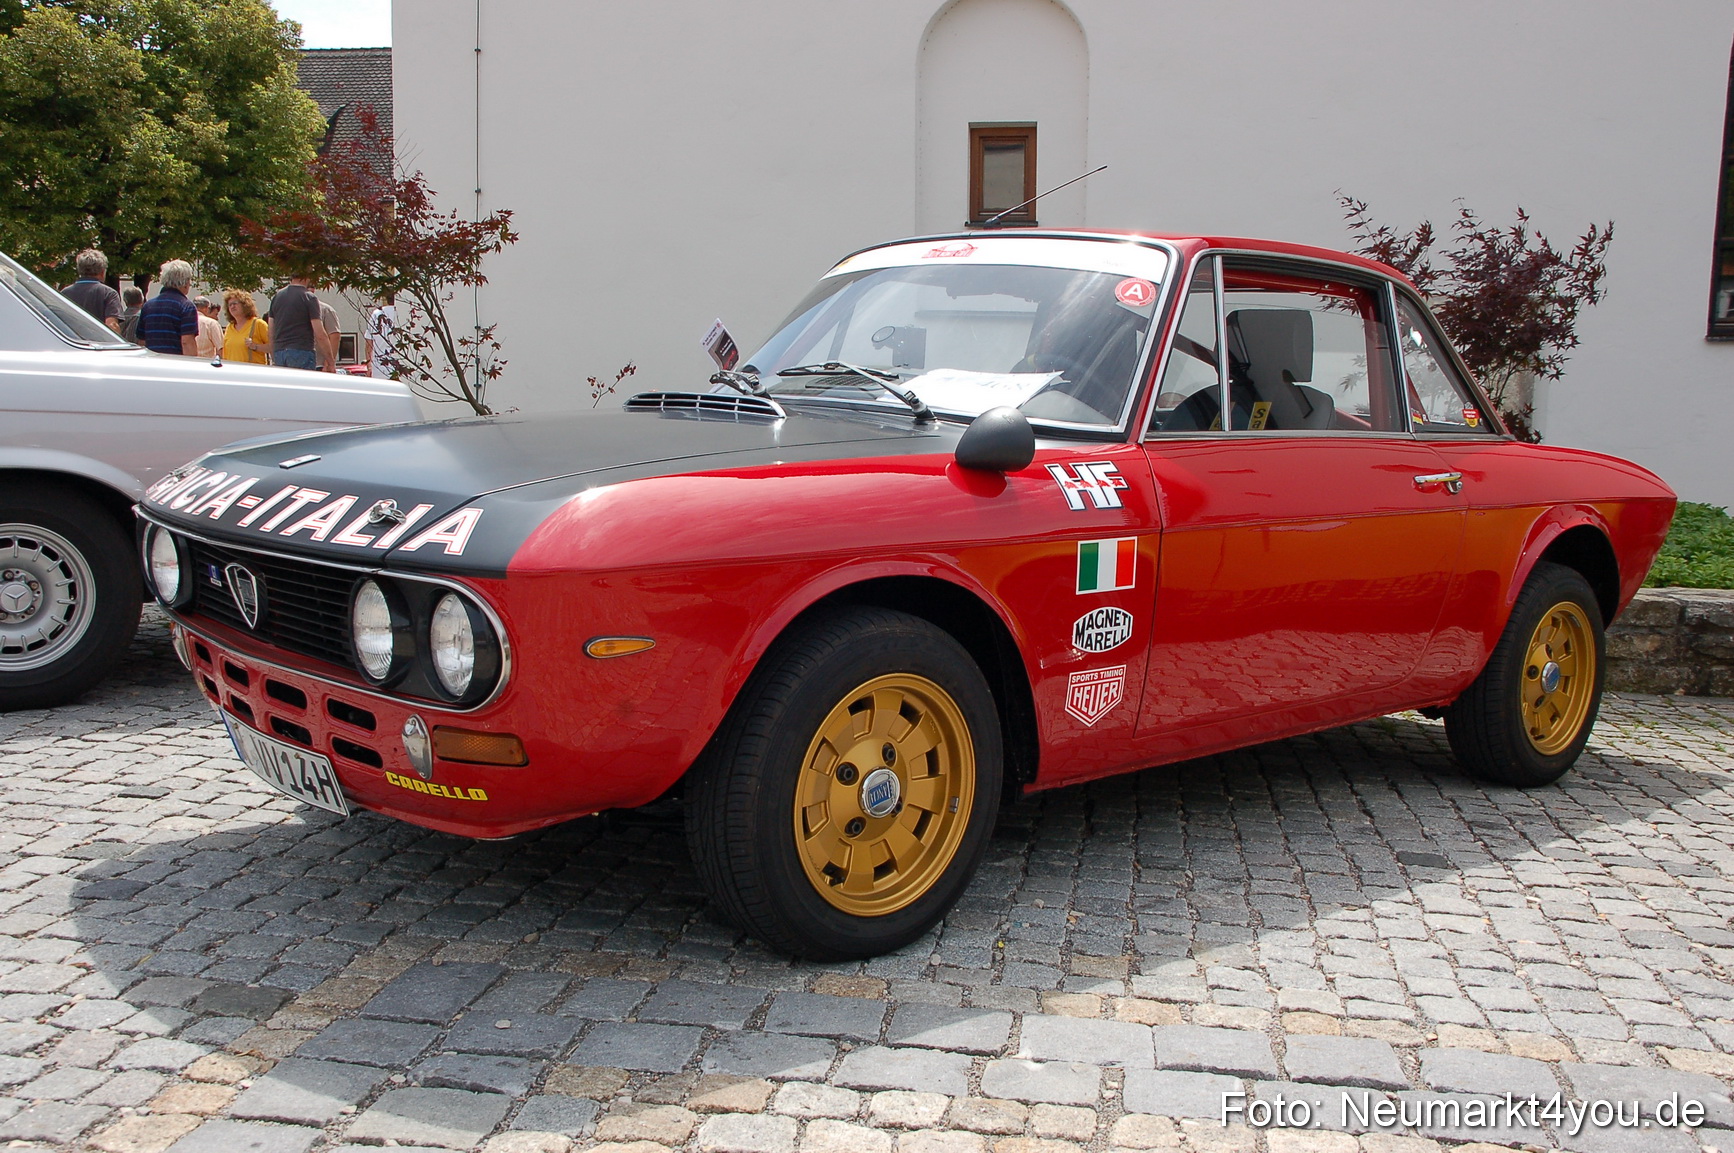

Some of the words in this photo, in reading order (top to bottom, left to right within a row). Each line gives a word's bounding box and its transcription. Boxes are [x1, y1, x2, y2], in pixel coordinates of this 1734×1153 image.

[1044, 460, 1130, 512] HF
[1074, 608, 1131, 640] MAGNETI
[1071, 672, 1099, 683] SPORTS
[1100, 668, 1124, 680] TIMING
[1072, 681, 1119, 717] HEUER
[385, 770, 489, 801] CARELLO
